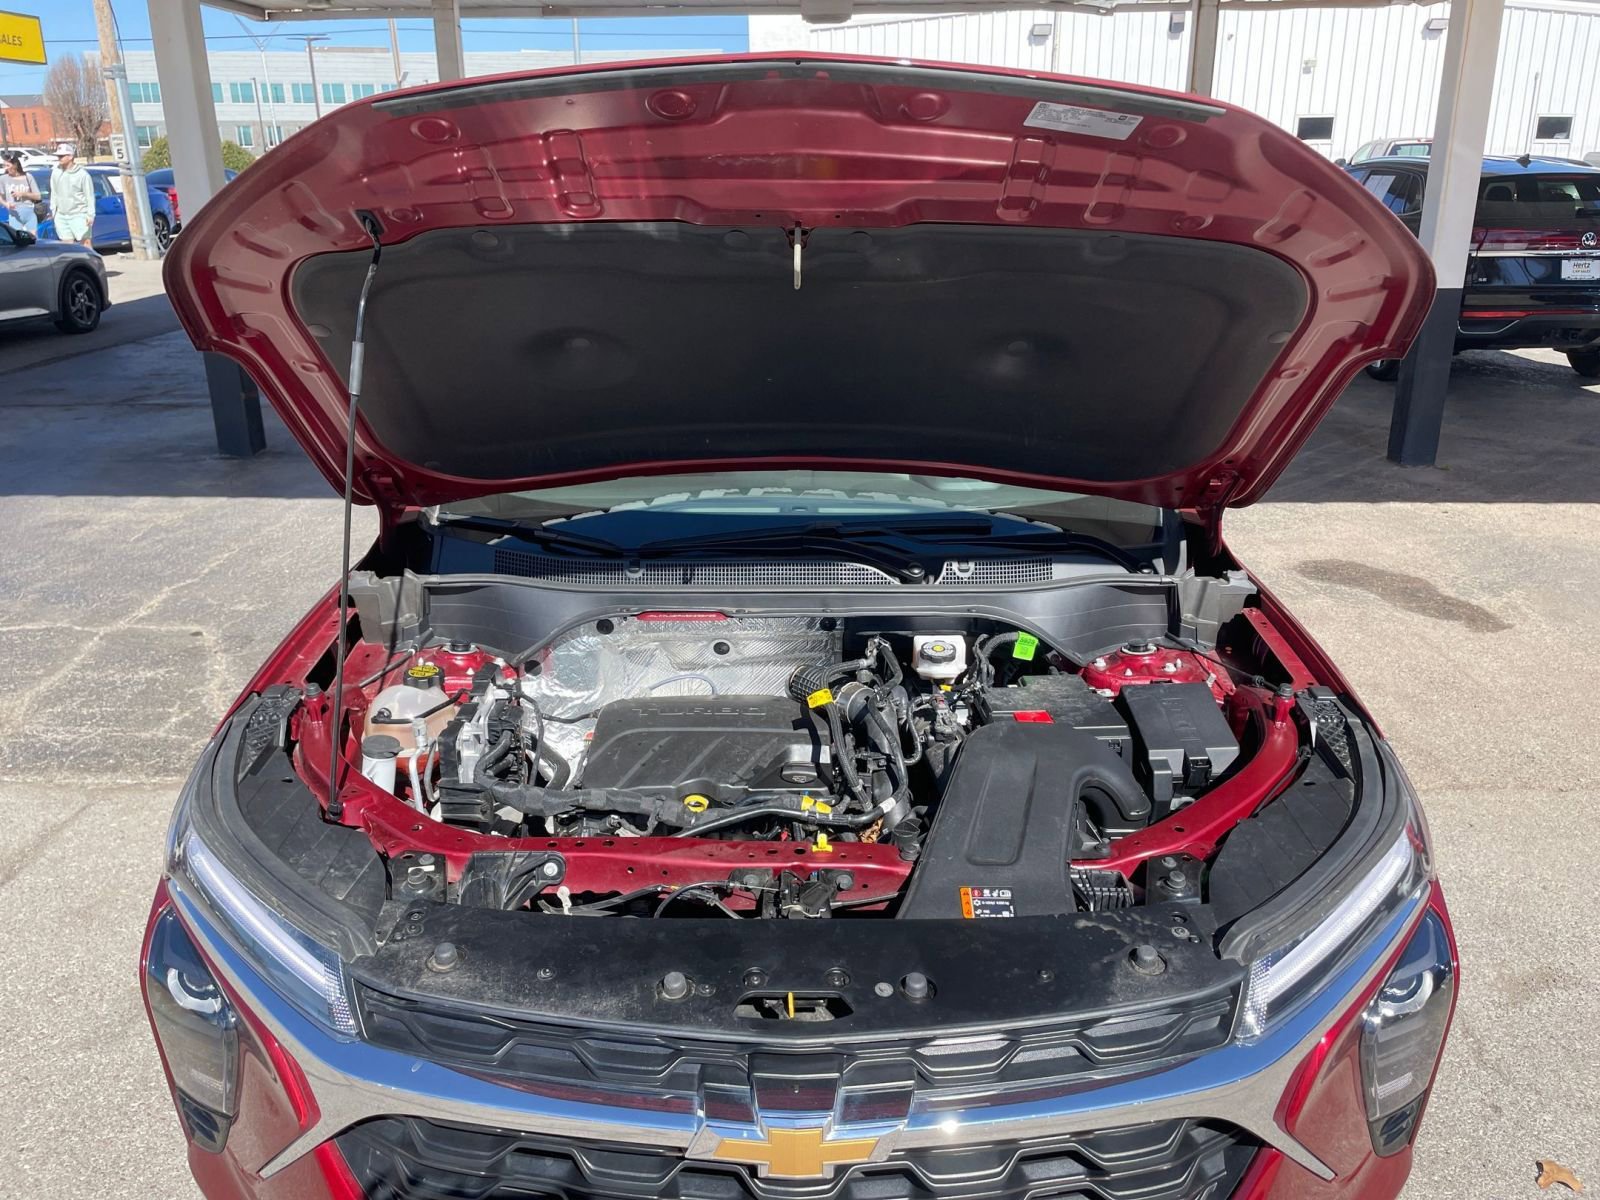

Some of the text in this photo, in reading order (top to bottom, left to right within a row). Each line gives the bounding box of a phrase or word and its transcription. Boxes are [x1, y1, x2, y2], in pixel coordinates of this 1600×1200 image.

[0, 33, 23, 47] ALES
[116, 148, 124, 159] 5
[631, 705, 767, 717] TURBO
